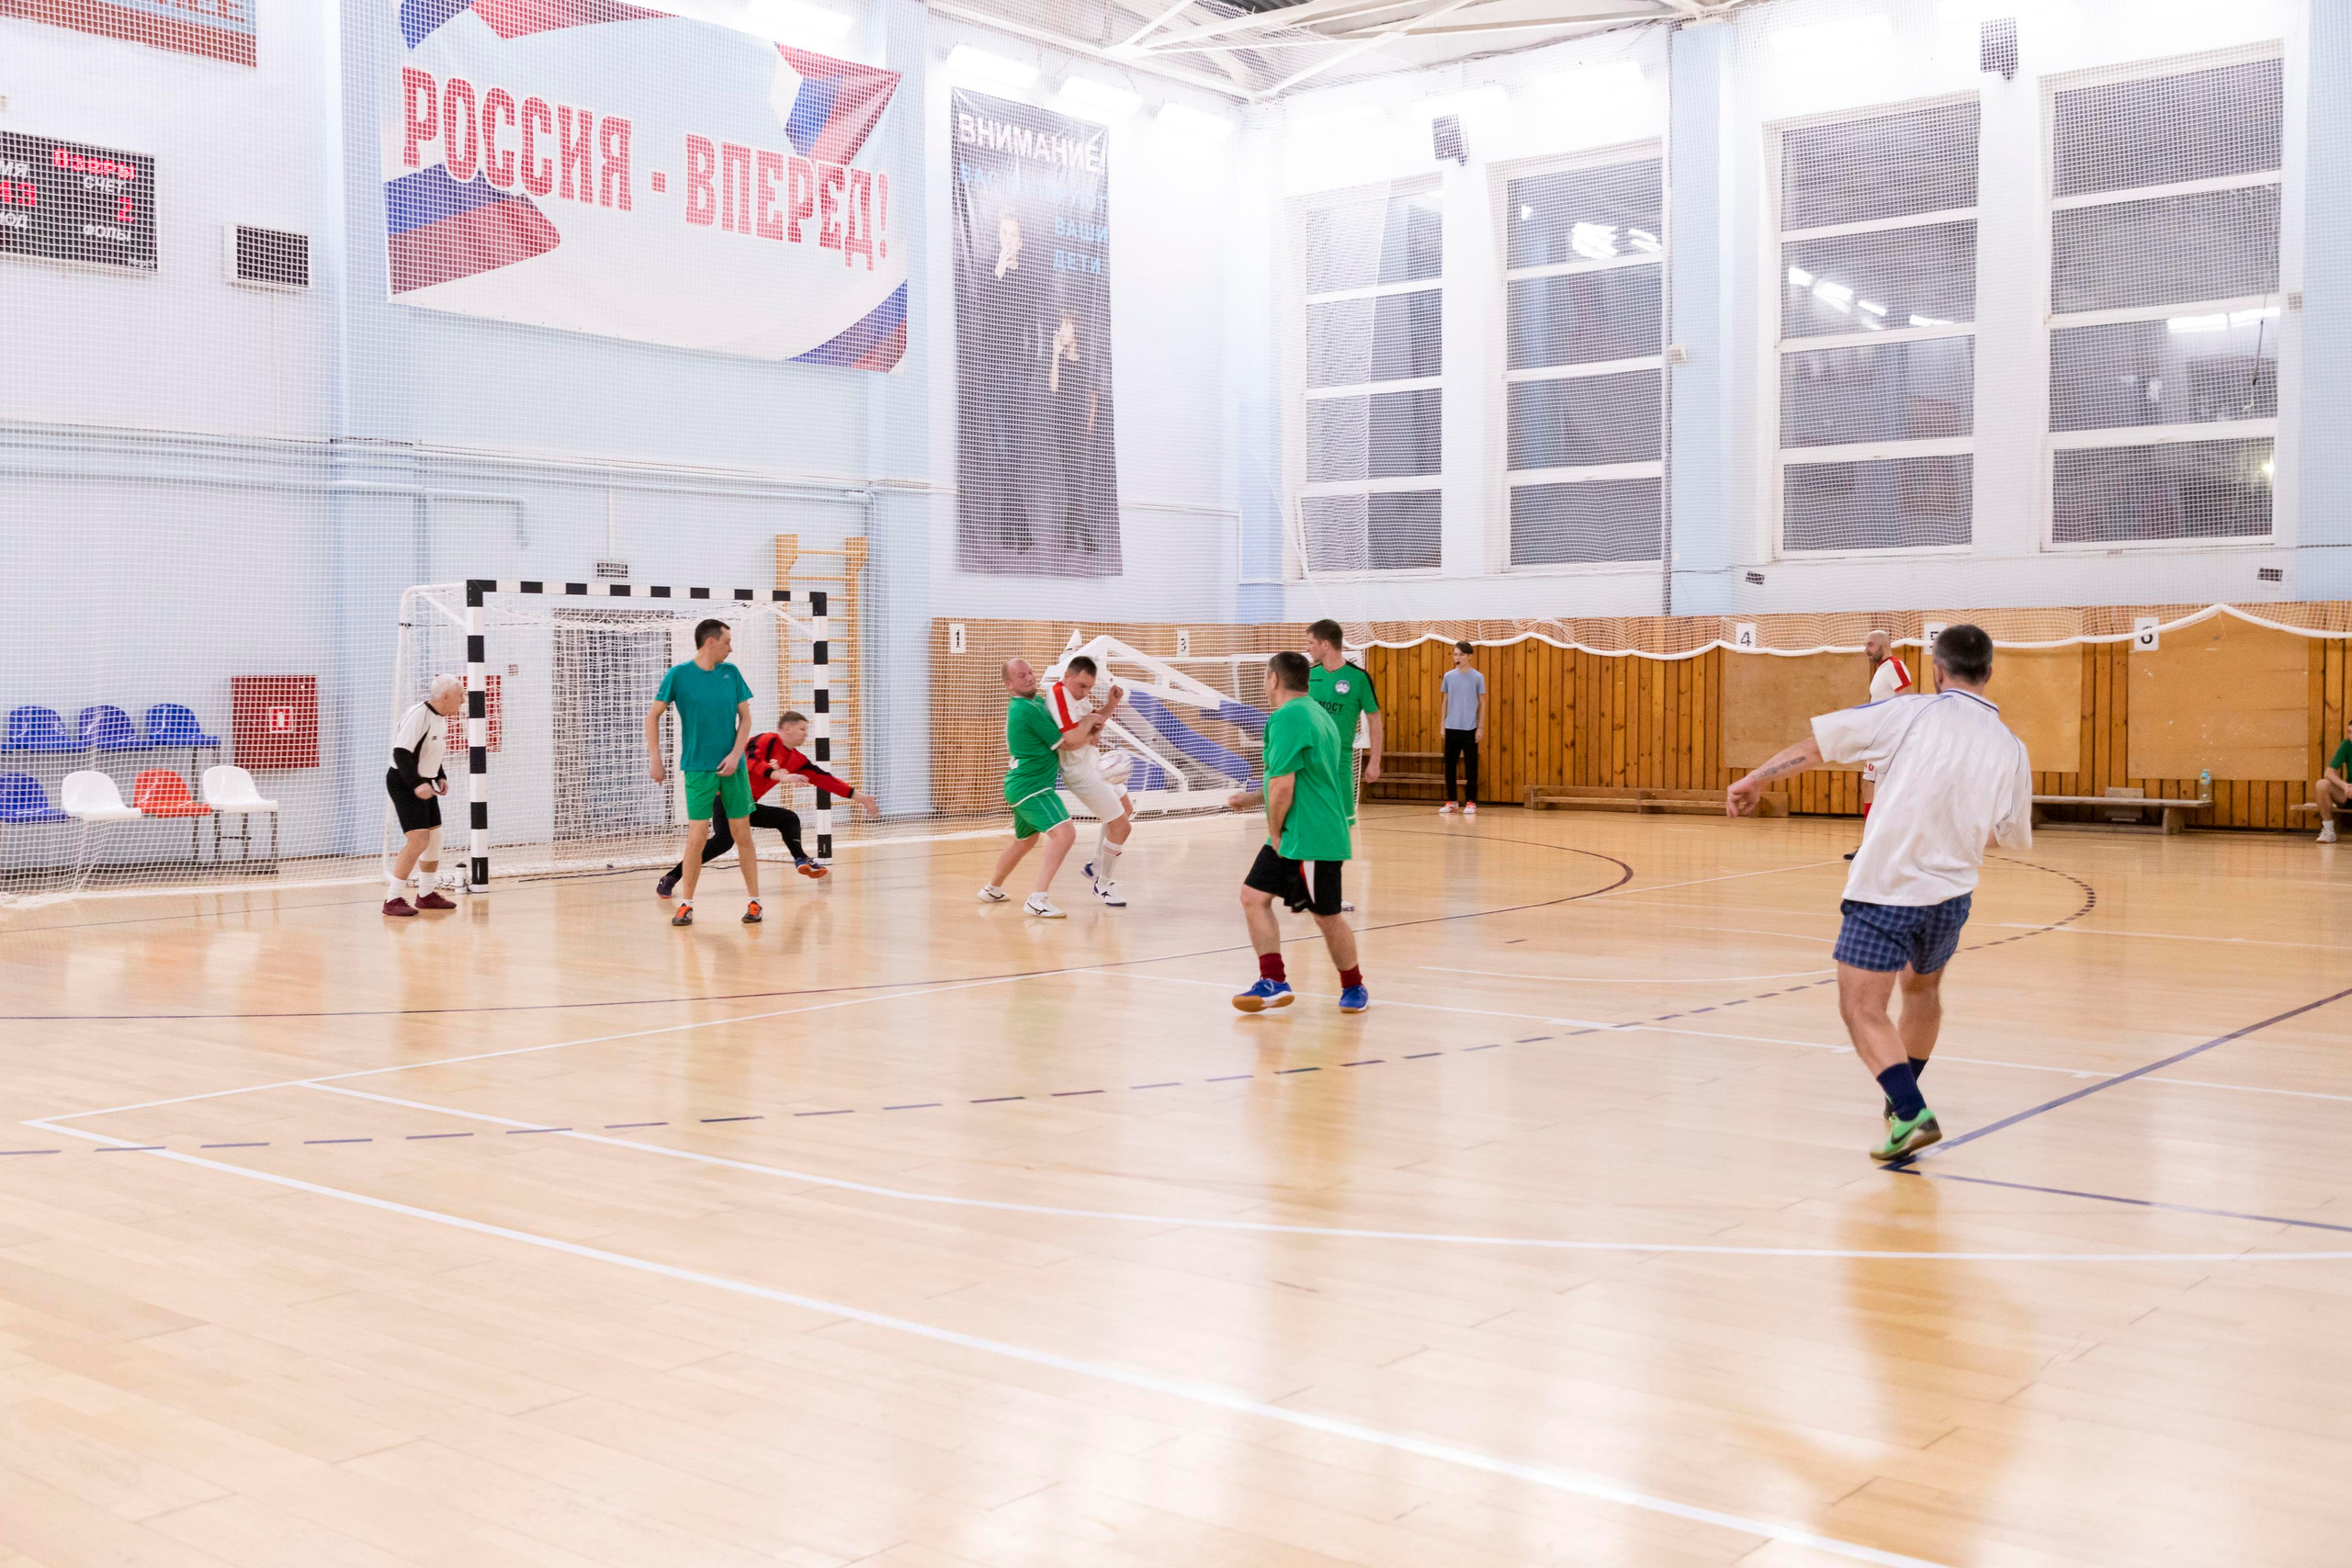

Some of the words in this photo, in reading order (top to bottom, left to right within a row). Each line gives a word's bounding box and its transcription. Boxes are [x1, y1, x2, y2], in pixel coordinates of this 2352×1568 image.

[958, 112, 1106, 175] ВНИМАНИЕ!
[401, 66, 631, 211] РОССИЯ
[685, 132, 888, 272] ВПЕРЕД!
[84, 175, 126, 195] СЧЕТ
[118, 197, 134, 222] 2
[83, 224, 131, 242] ФОЛЫ
[955, 629, 961, 649] 1
[1740, 631, 1752, 647] 4
